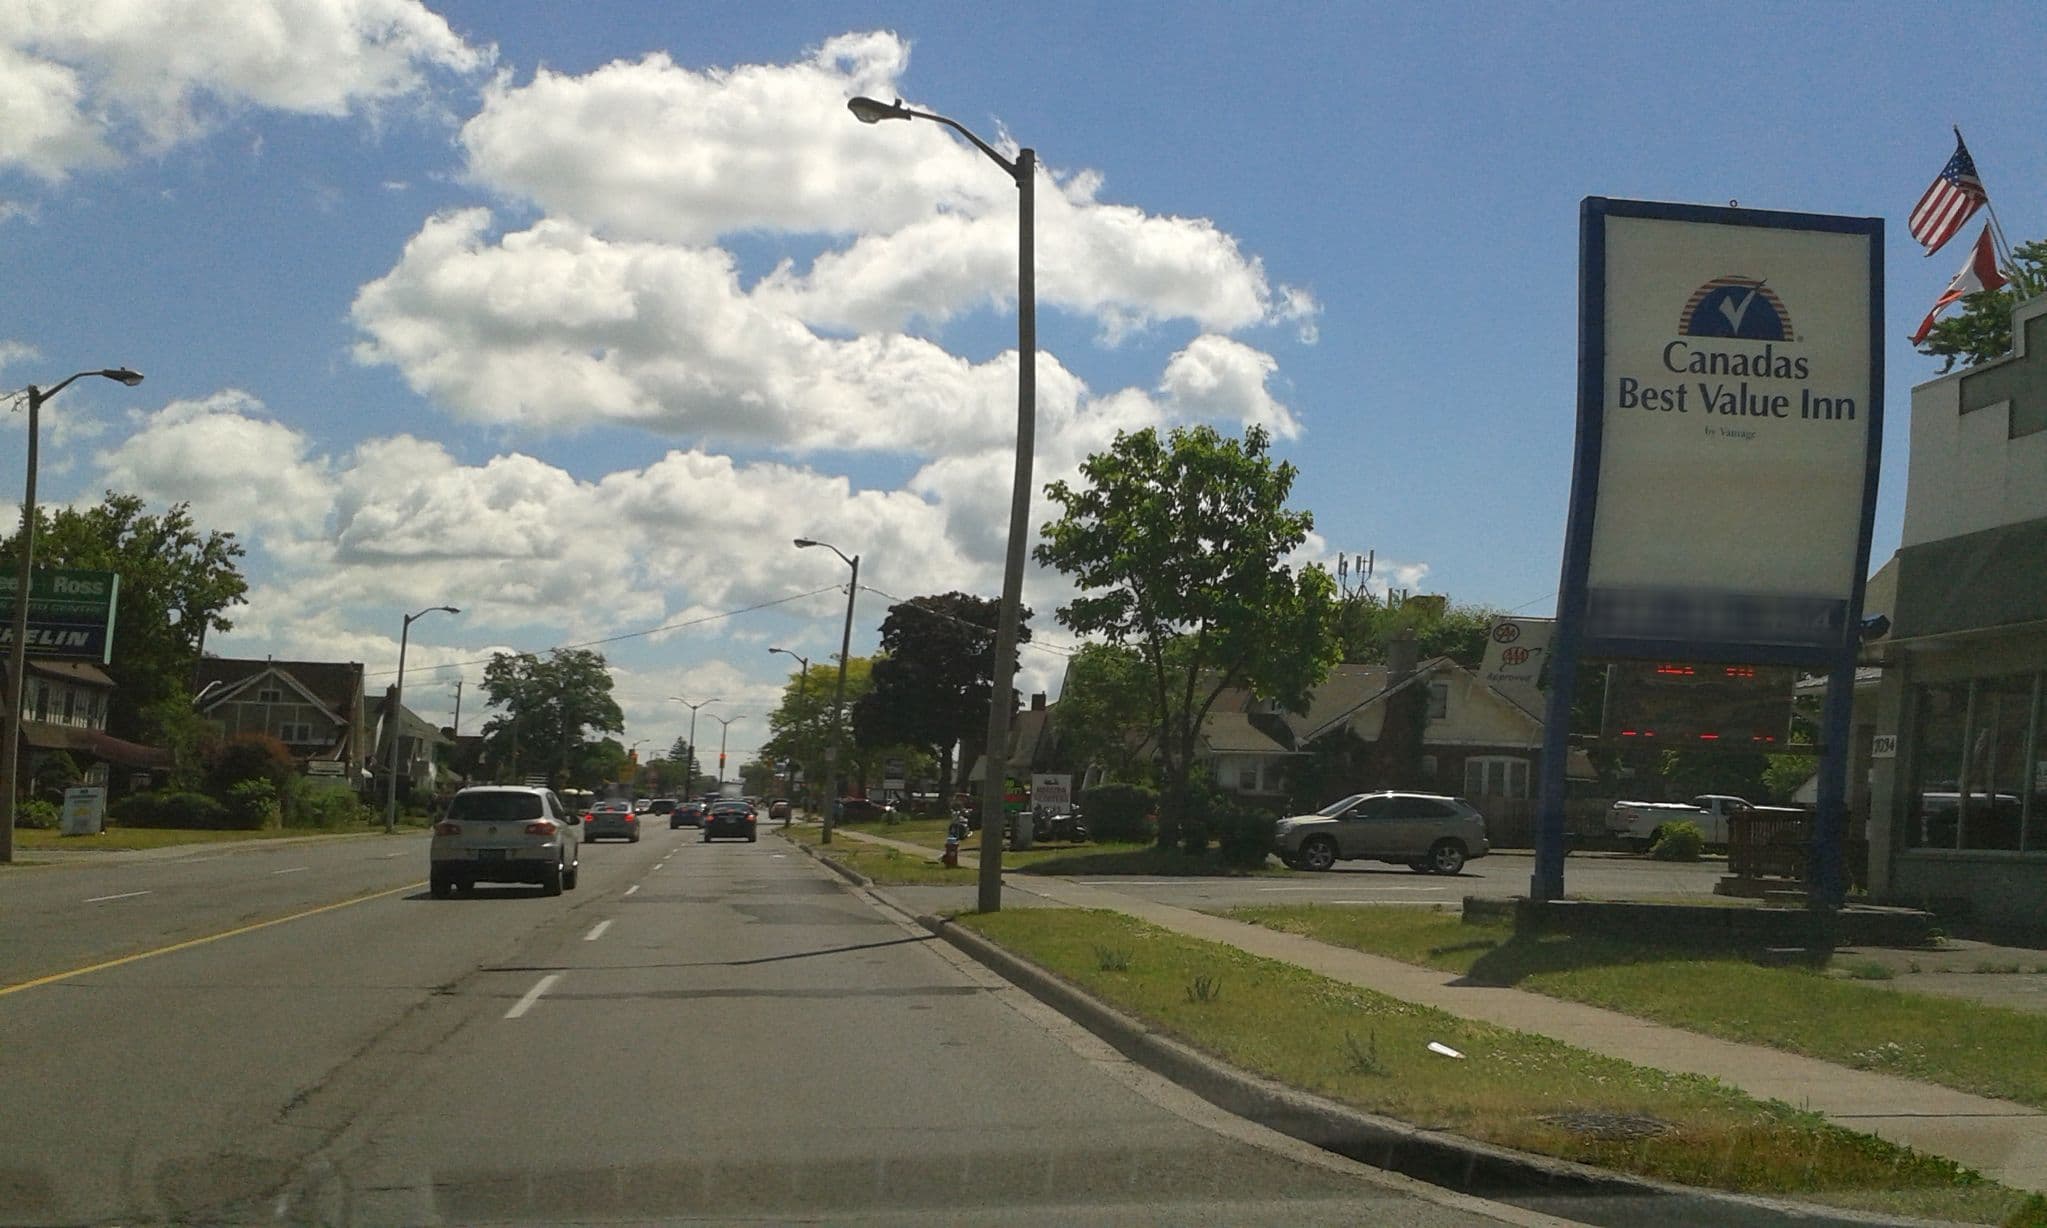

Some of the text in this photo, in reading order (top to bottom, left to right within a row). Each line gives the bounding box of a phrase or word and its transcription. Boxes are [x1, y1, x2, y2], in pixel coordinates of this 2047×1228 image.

[1663, 340, 1809, 379] Canadas
[1619, 377, 1856, 420] Best Value Inn
[53, 576, 104, 594] Ross
